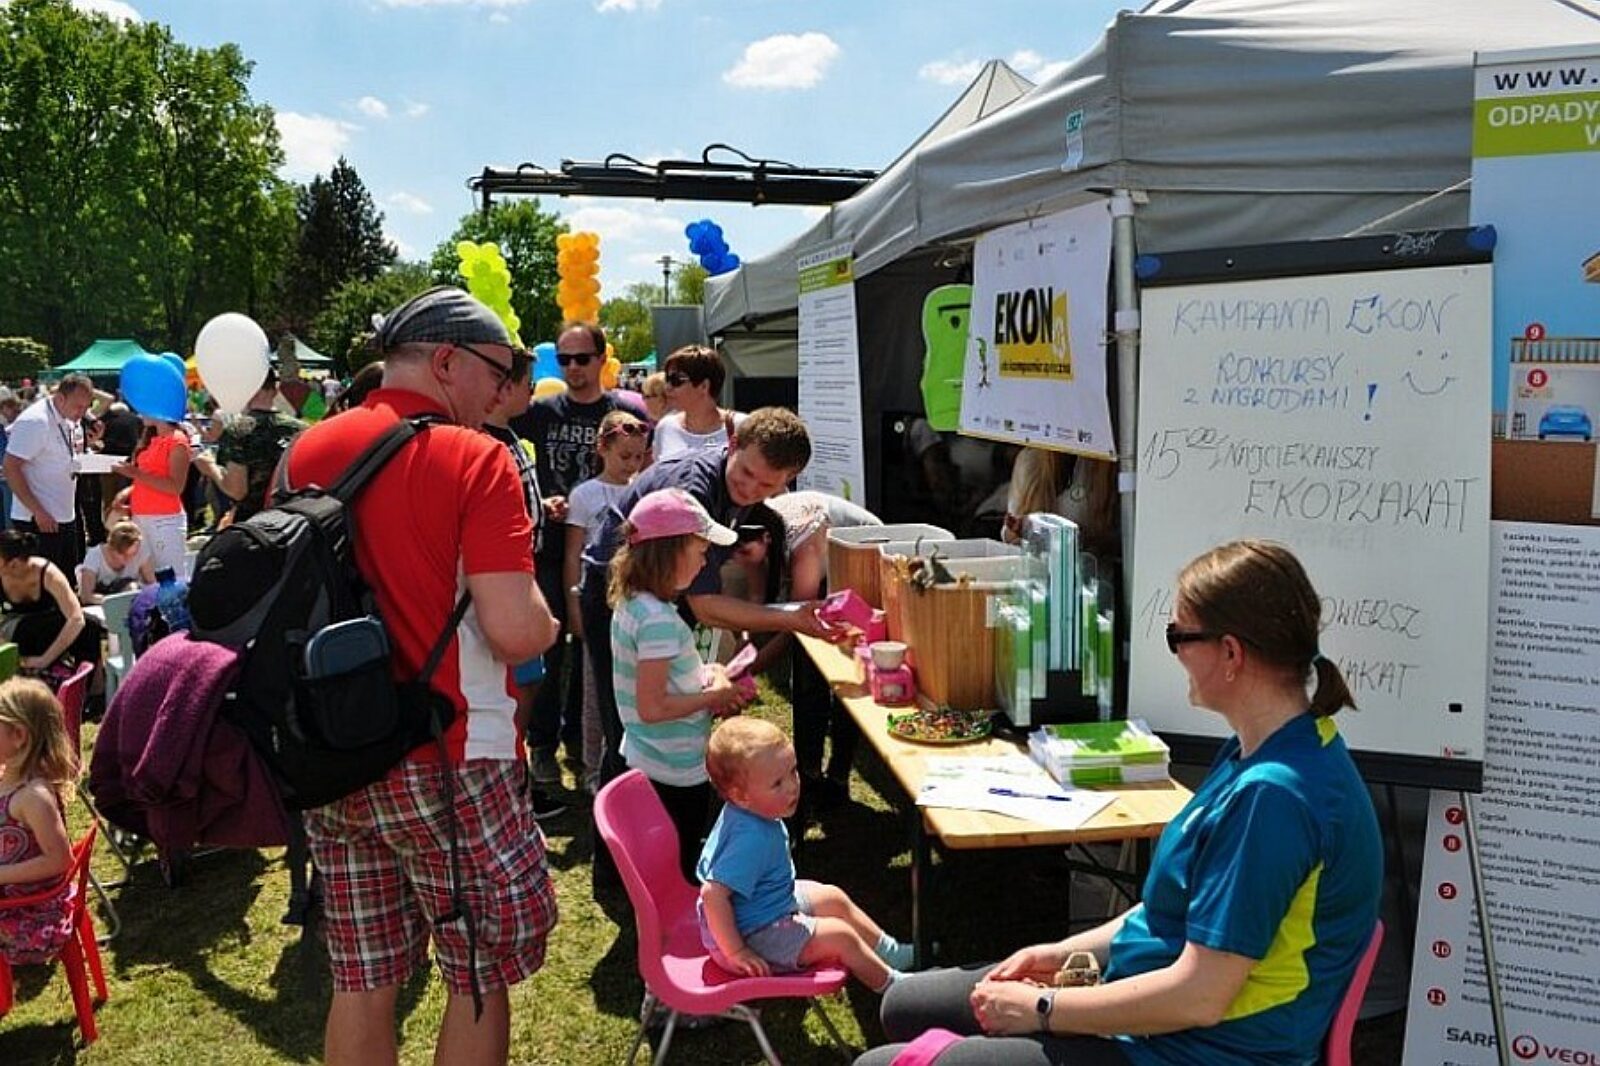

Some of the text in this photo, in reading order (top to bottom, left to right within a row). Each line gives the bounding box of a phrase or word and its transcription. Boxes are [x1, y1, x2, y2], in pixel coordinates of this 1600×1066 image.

[1488, 100, 1599, 128] ODPADY
[994, 286, 1053, 346] EKON
[1346, 293, 1460, 335] EKON
